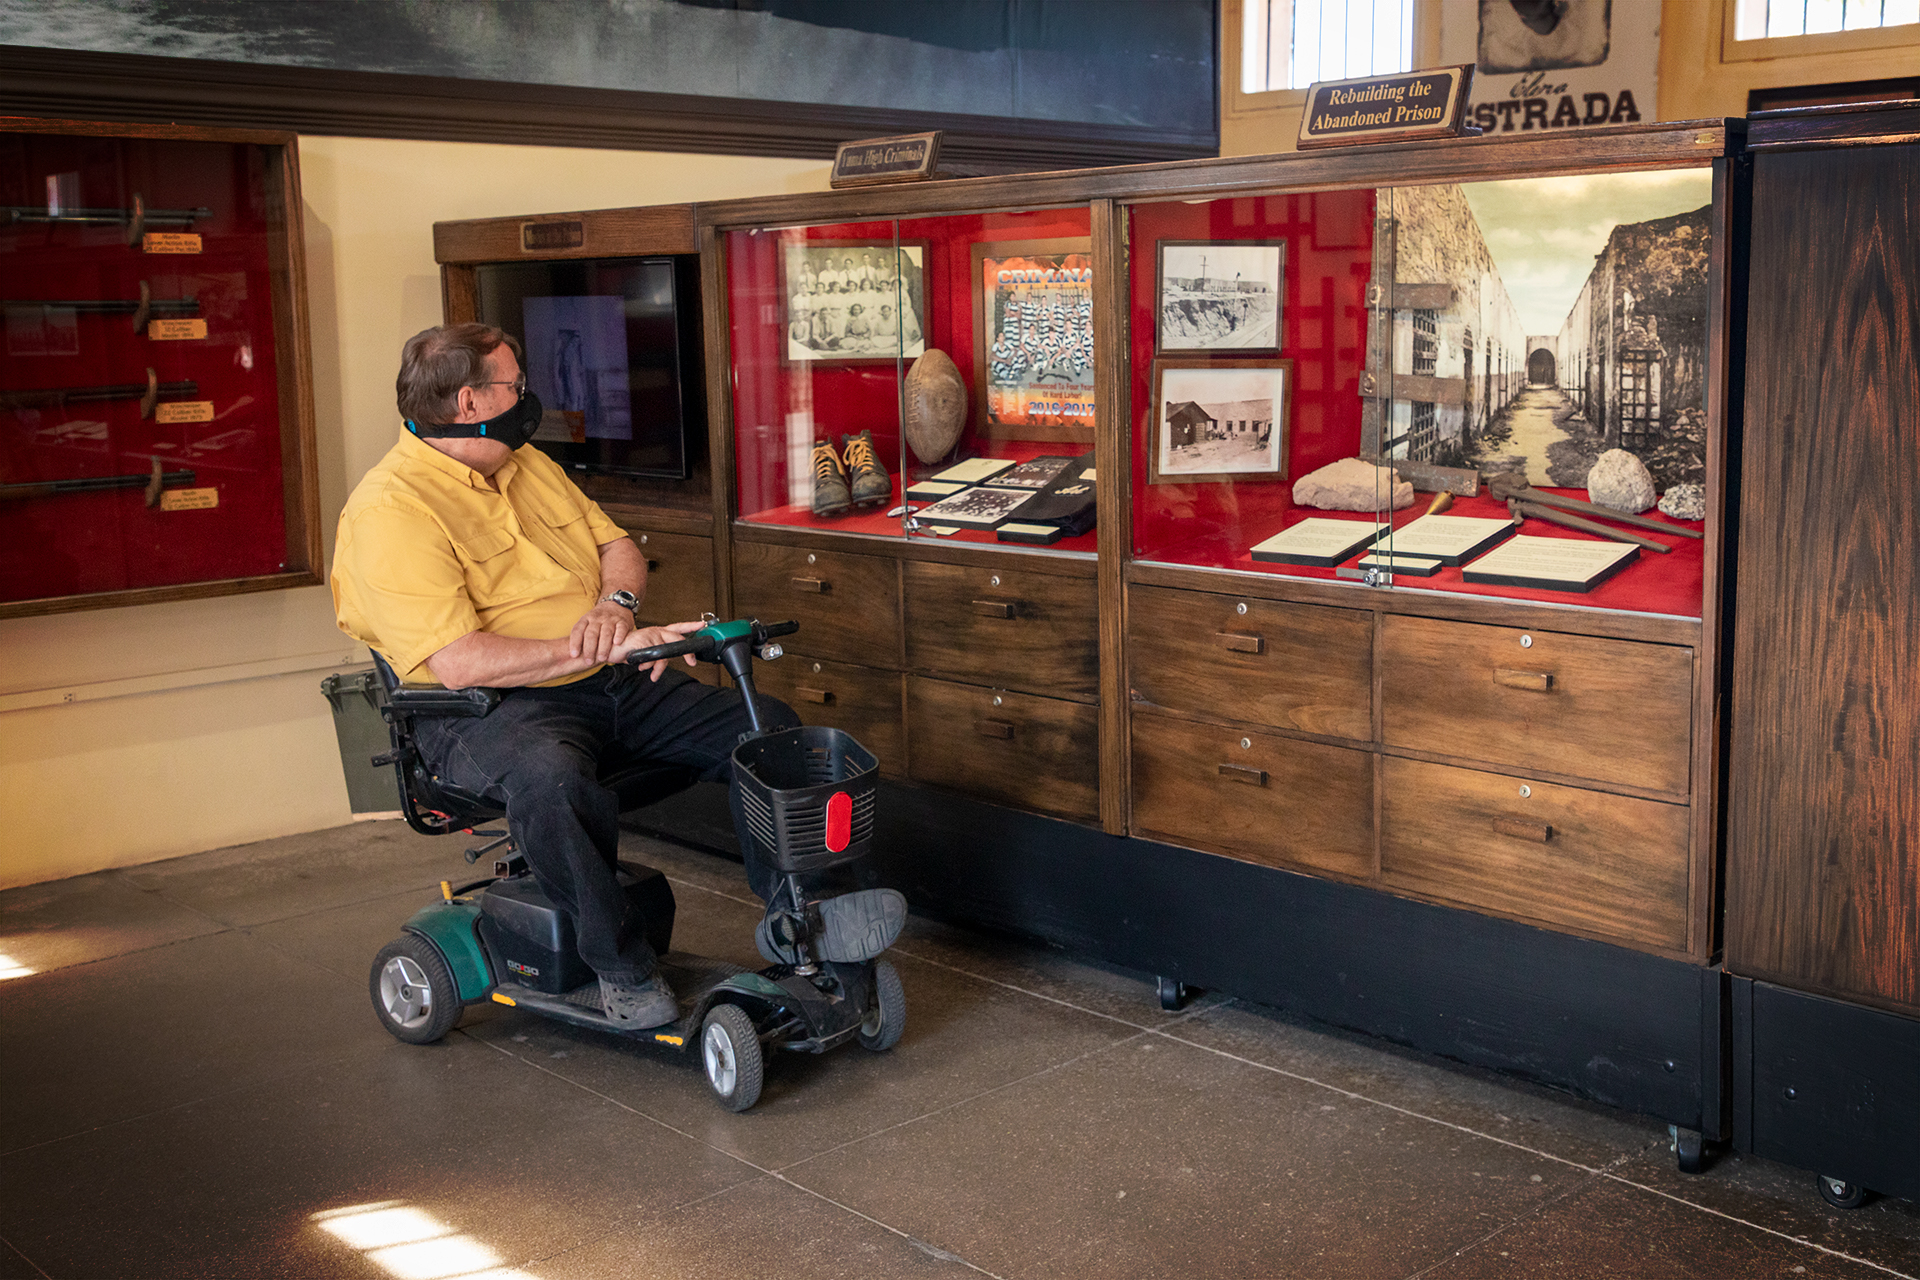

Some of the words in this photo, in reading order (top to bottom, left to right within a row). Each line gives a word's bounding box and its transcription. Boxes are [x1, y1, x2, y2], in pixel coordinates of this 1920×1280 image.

[1328, 84, 1405, 105] Rebuilding
[1408, 80, 1432, 97] the
[1311, 107, 1392, 131] Abandoned
[1394, 104, 1441, 123] Prison
[864, 149, 883, 169] High
[885, 145, 923, 163] Criminals
[1028, 401, 1095, 417] 2016-2017
